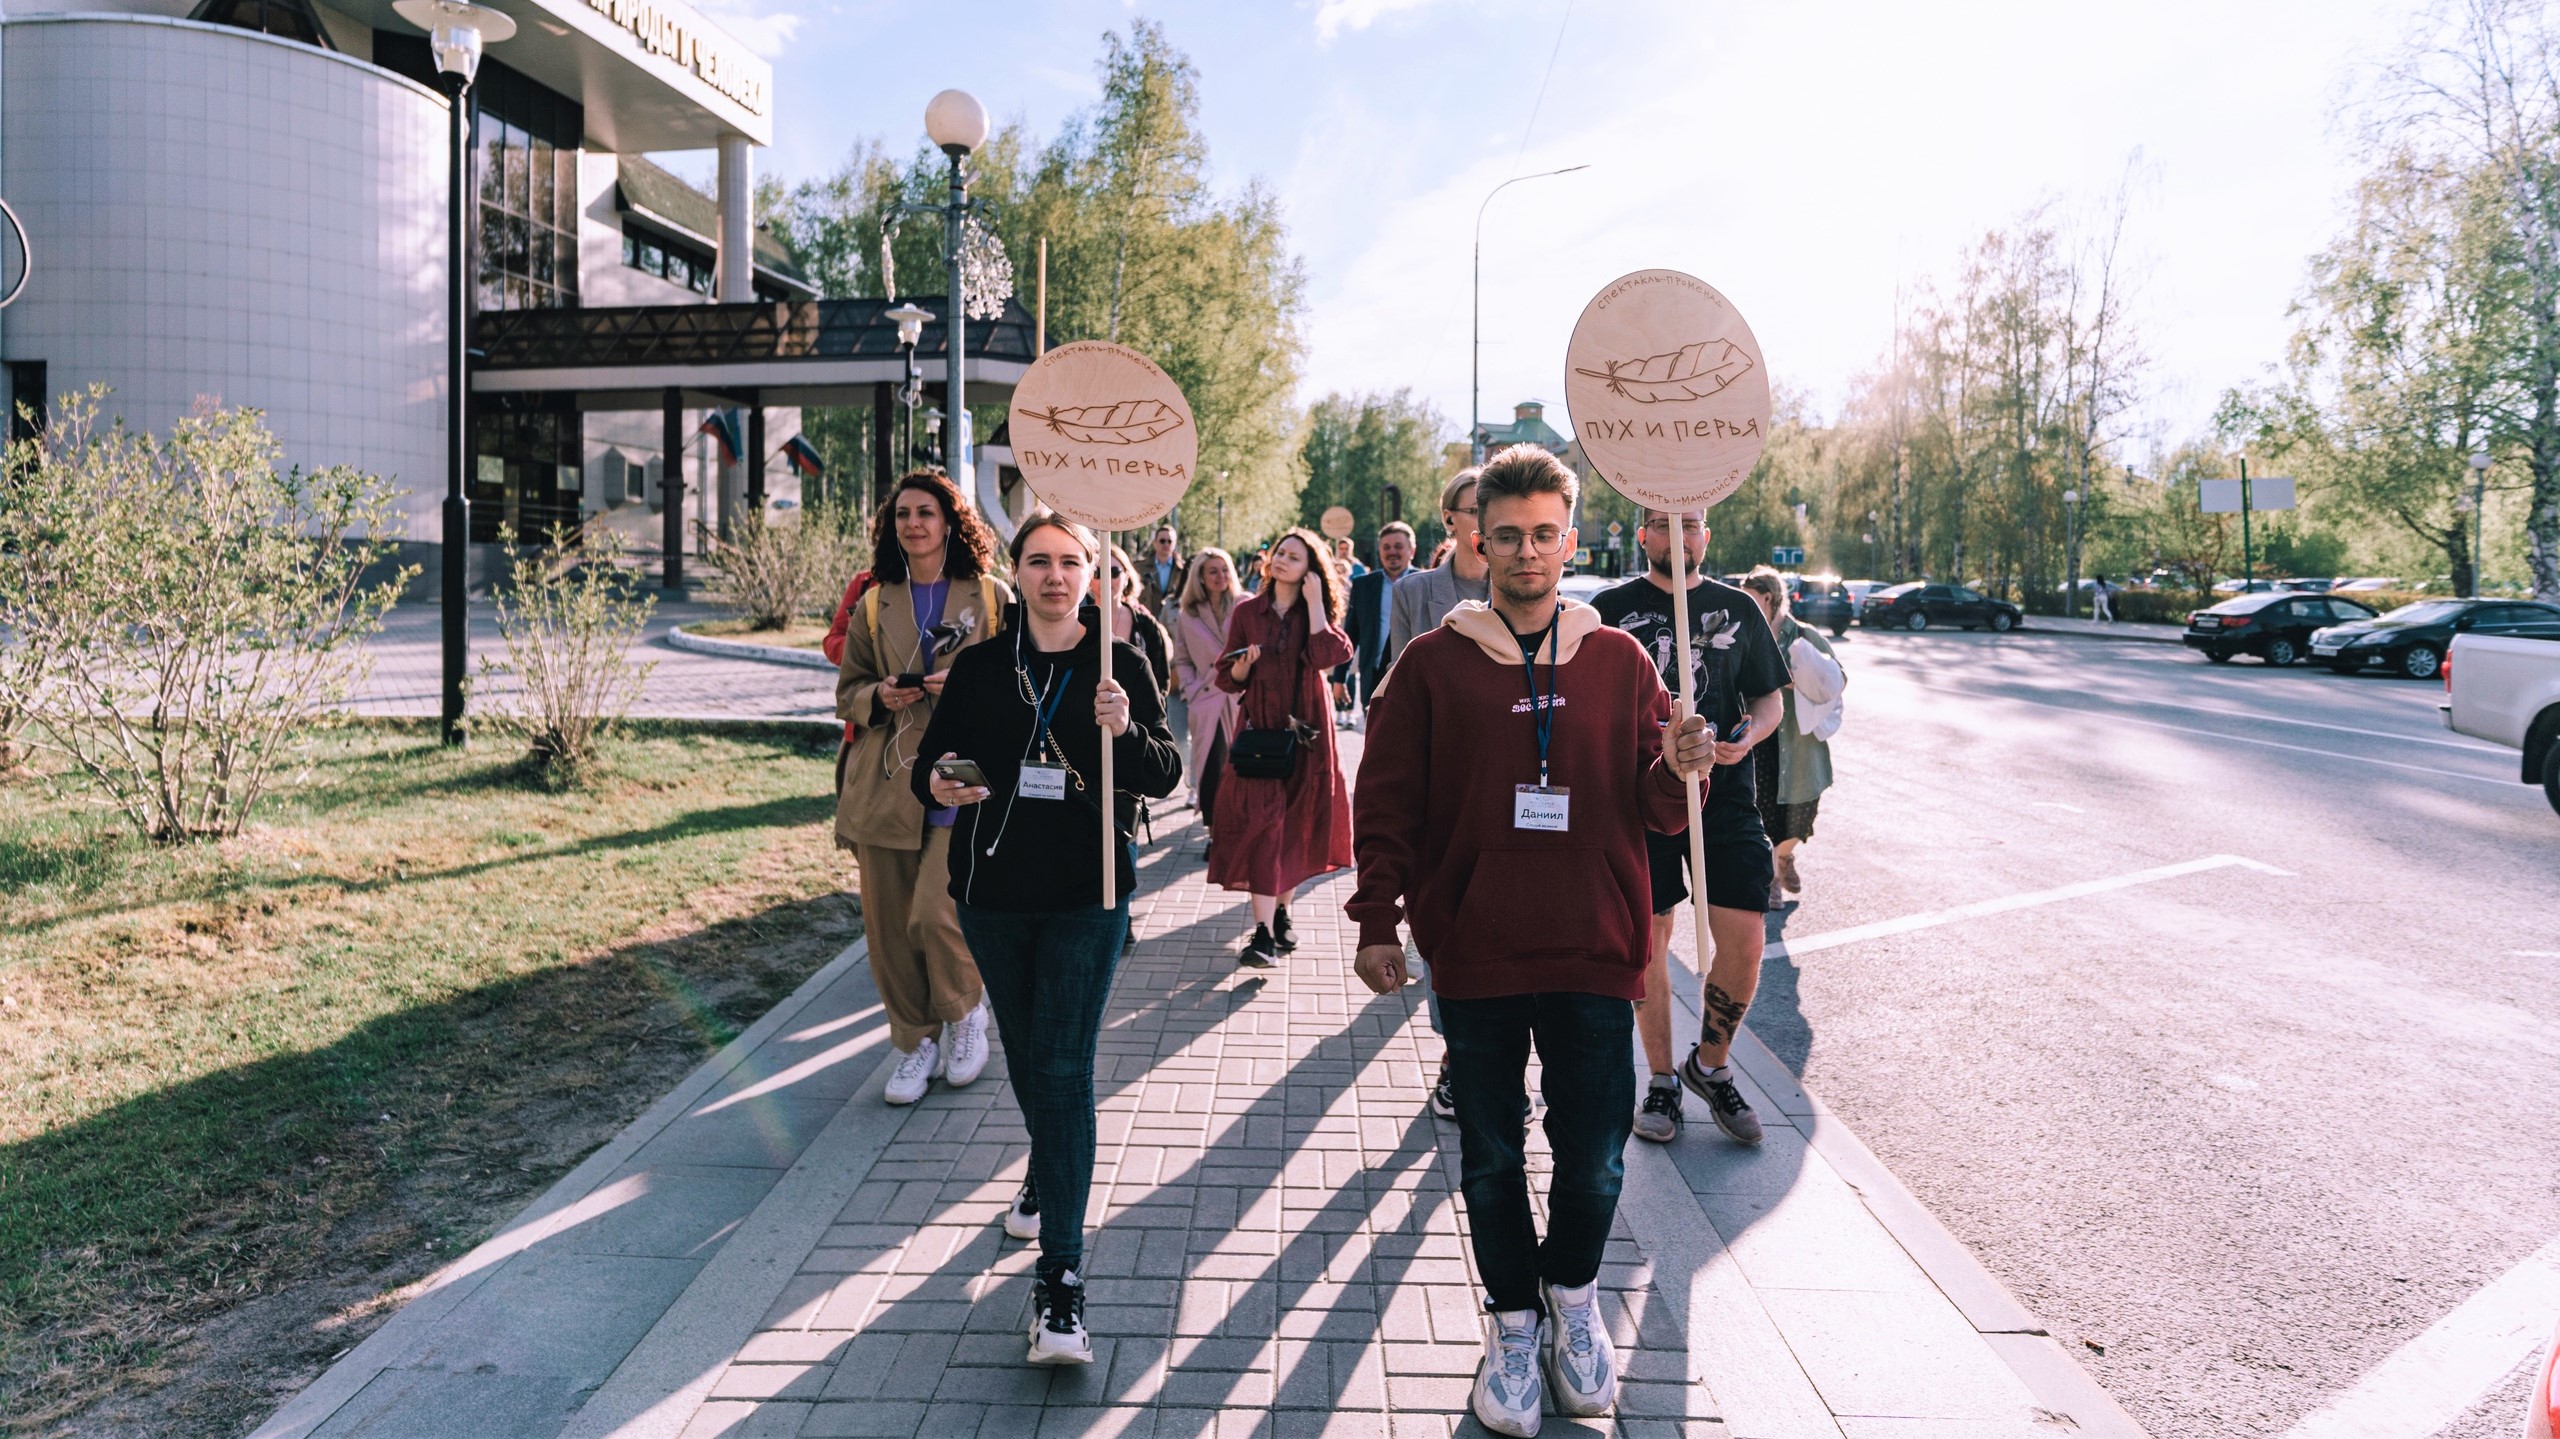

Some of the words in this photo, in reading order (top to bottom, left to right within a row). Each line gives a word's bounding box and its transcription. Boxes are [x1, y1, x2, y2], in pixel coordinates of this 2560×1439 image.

[680, 26, 694, 68] И
[1585, 419, 1634, 441] ПУХ
[1645, 420, 1665, 438] И
[1024, 450, 1069, 469] ПУХ
[1080, 456, 1097, 471] И
[1022, 782, 1063, 790] Анастасия
[1520, 808, 1564, 820] Даниил
